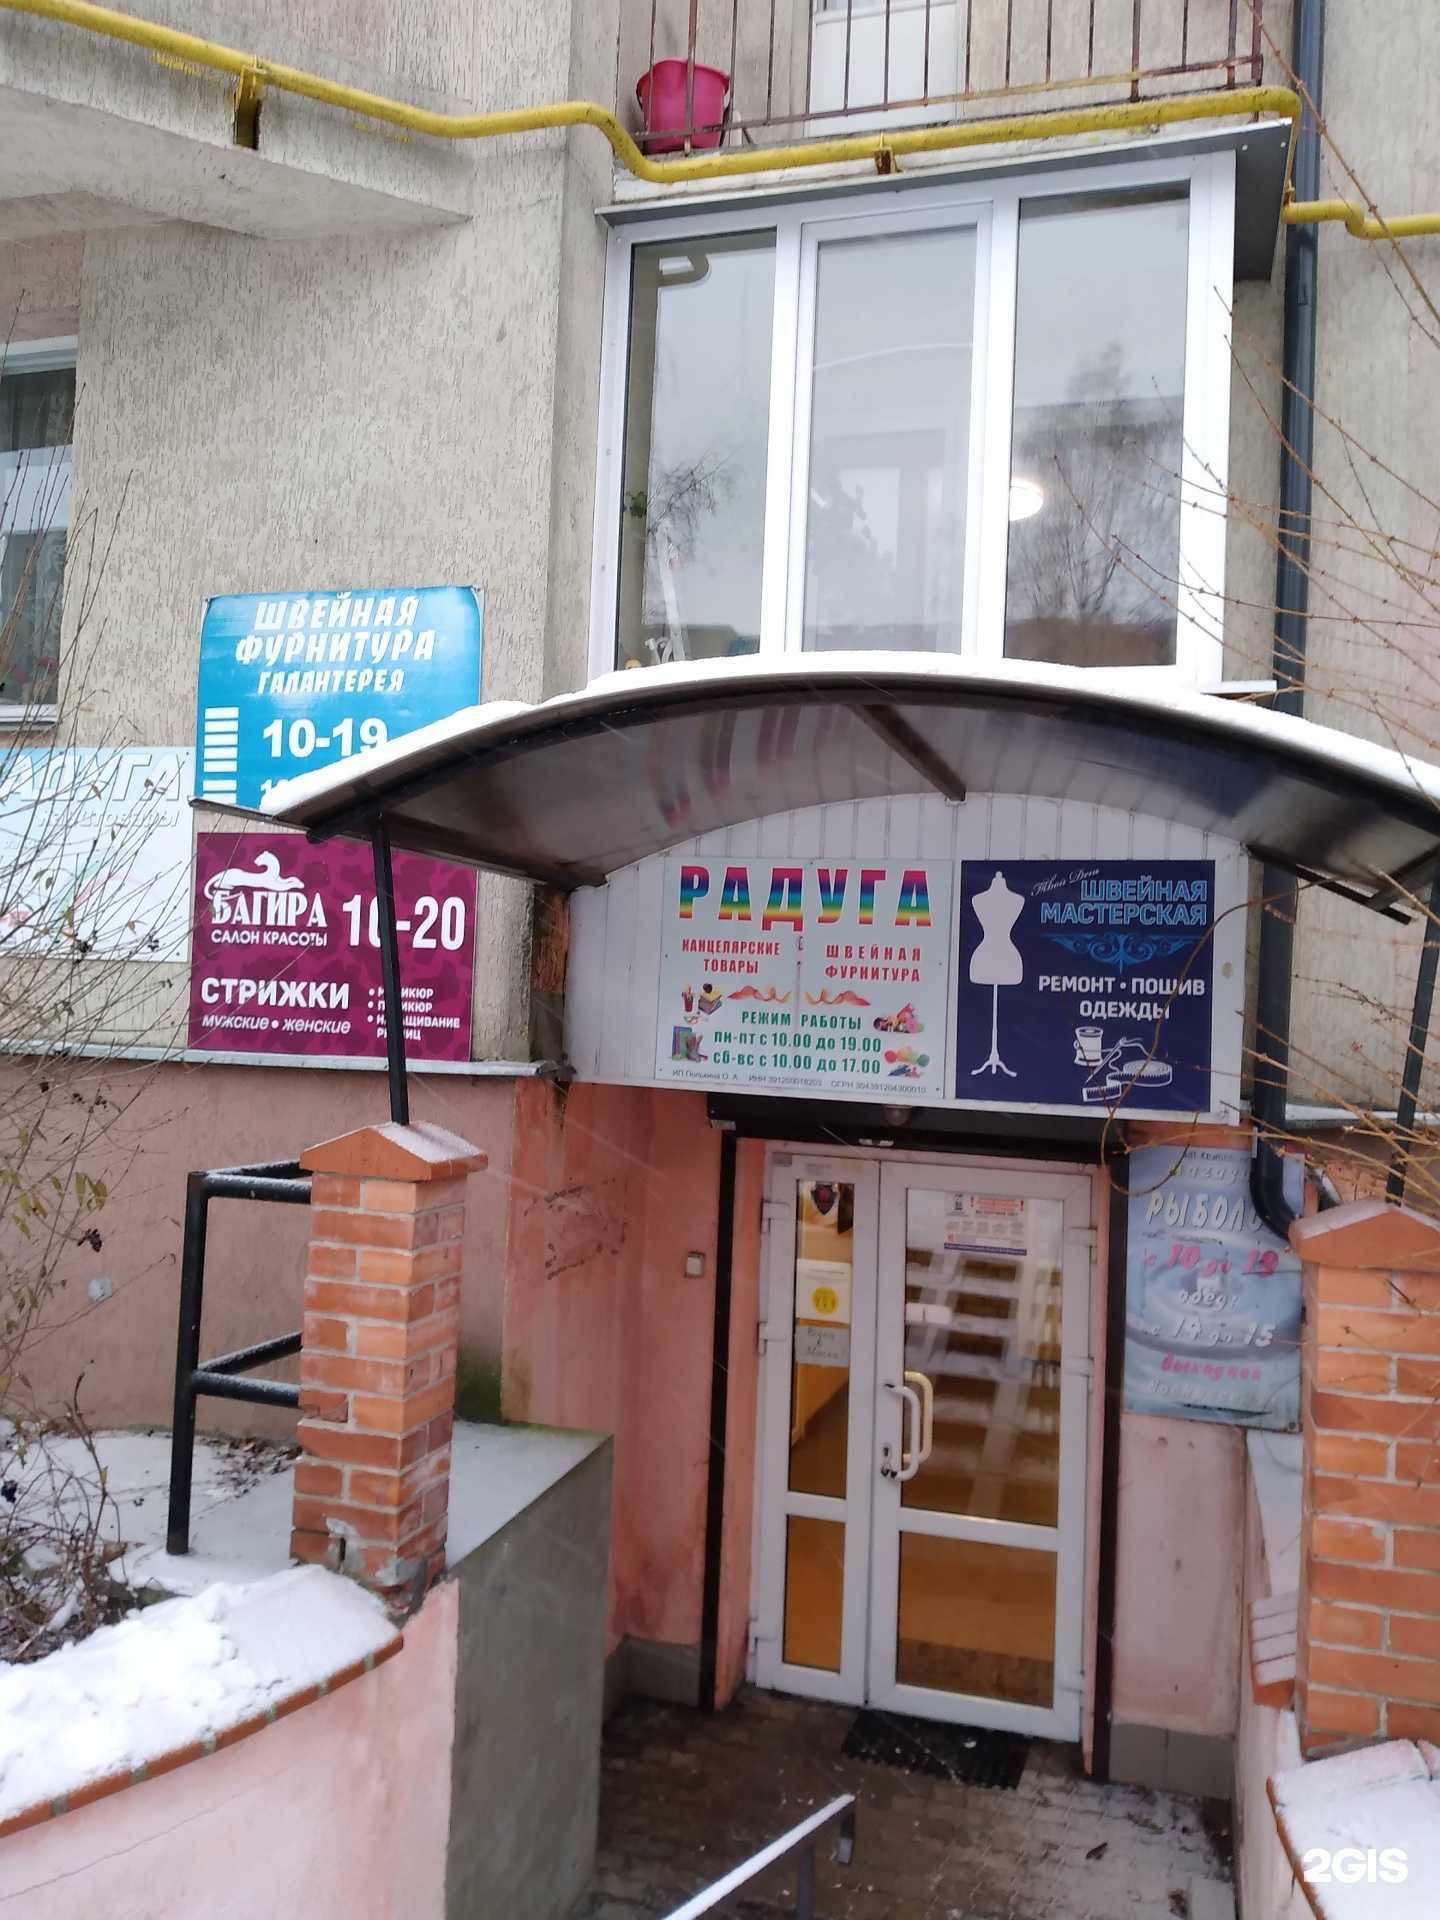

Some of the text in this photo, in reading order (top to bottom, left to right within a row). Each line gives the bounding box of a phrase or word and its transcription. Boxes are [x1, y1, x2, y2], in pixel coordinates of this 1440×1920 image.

[254, 592, 419, 630] ШВЕЙНАЯ
[235, 629, 437, 666] ФУРНИТУРА
[258, 668, 405, 694] ГАЛАНТЕРЕЯ
[262, 718, 389, 758] 10-19
[1080, 875, 1208, 902] ШВЕЙНАЯ
[211, 889, 328, 928] БАГИРА
[679, 866, 932, 932] РАДУГА
[1040, 902, 1207, 926] МАСТЕРСКАЯ
[211, 929, 328, 947] САЛОН КРАСОТЫ
[682, 938, 781, 956] КАНЦЕЛЯРСКИЕ
[825, 943, 922, 962] ШВЕЙНАЯ
[703, 958, 759, 974] ТОВАРЫ
[825, 965, 921, 983] ФУРНИТУРА
[201, 977, 350, 1010] СТРИЖКИ
[377, 986, 434, 999] МИКЮР
[1038, 975, 1206, 996] РЕМОНТ ПОШИВ
[377, 999, 433, 1013] ПИКЮР
[1079, 1000, 1171, 1021] ОДЕЖДЫ
[202, 1014, 351, 1034] мужские женские
[376, 1014, 460, 1029] НЩИВАНИЕ
[741, 1011, 862, 1030] РЕЖИМ РАБОТЫ
[771, 1033, 812, 1049] 10.00
[815, 1036, 836, 1051] до
[840, 1036, 882, 1053] 19.00
[771, 1054, 812, 1070] 10.00
[816, 1057, 837, 1072] до
[841, 1058, 882, 1074] 17.00
